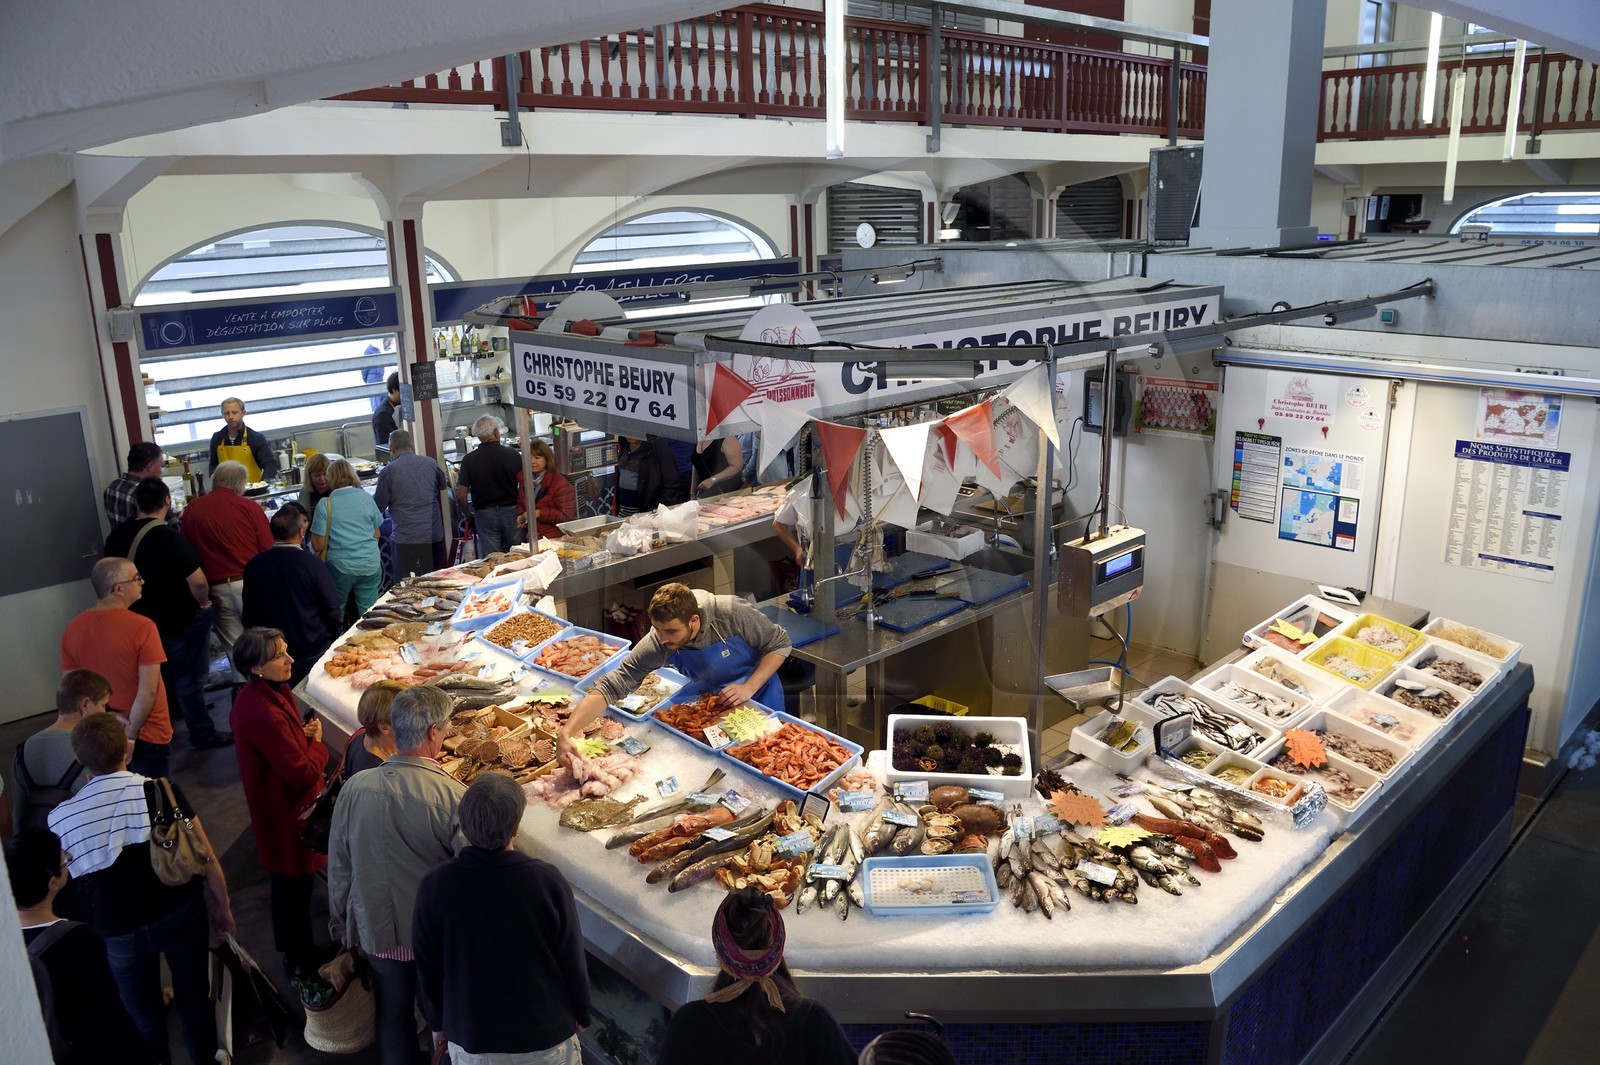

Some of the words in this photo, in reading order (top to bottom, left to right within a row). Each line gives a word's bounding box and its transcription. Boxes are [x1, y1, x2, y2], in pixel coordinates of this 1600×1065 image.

[224, 312, 258, 323] VENTE
[260, 310, 268, 320] A
[271, 306, 326, 319] EMPORTER
[288, 319, 310, 329] SUR
[314, 316, 344, 327] PLACE
[523, 351, 614, 387] CHRISTOPHE
[618, 365, 675, 396] BEURY
[526, 380, 547, 396] 05
[554, 384, 576, 401] 59
[583, 389, 608, 408] 22
[615, 395, 640, 413] 07
[648, 401, 676, 421] 64
[1273, 399, 1304, 408] Christophe
[1478, 449, 1518, 460] PRODUITS
[1496, 445, 1556, 458] SCIENTIFIQUES
